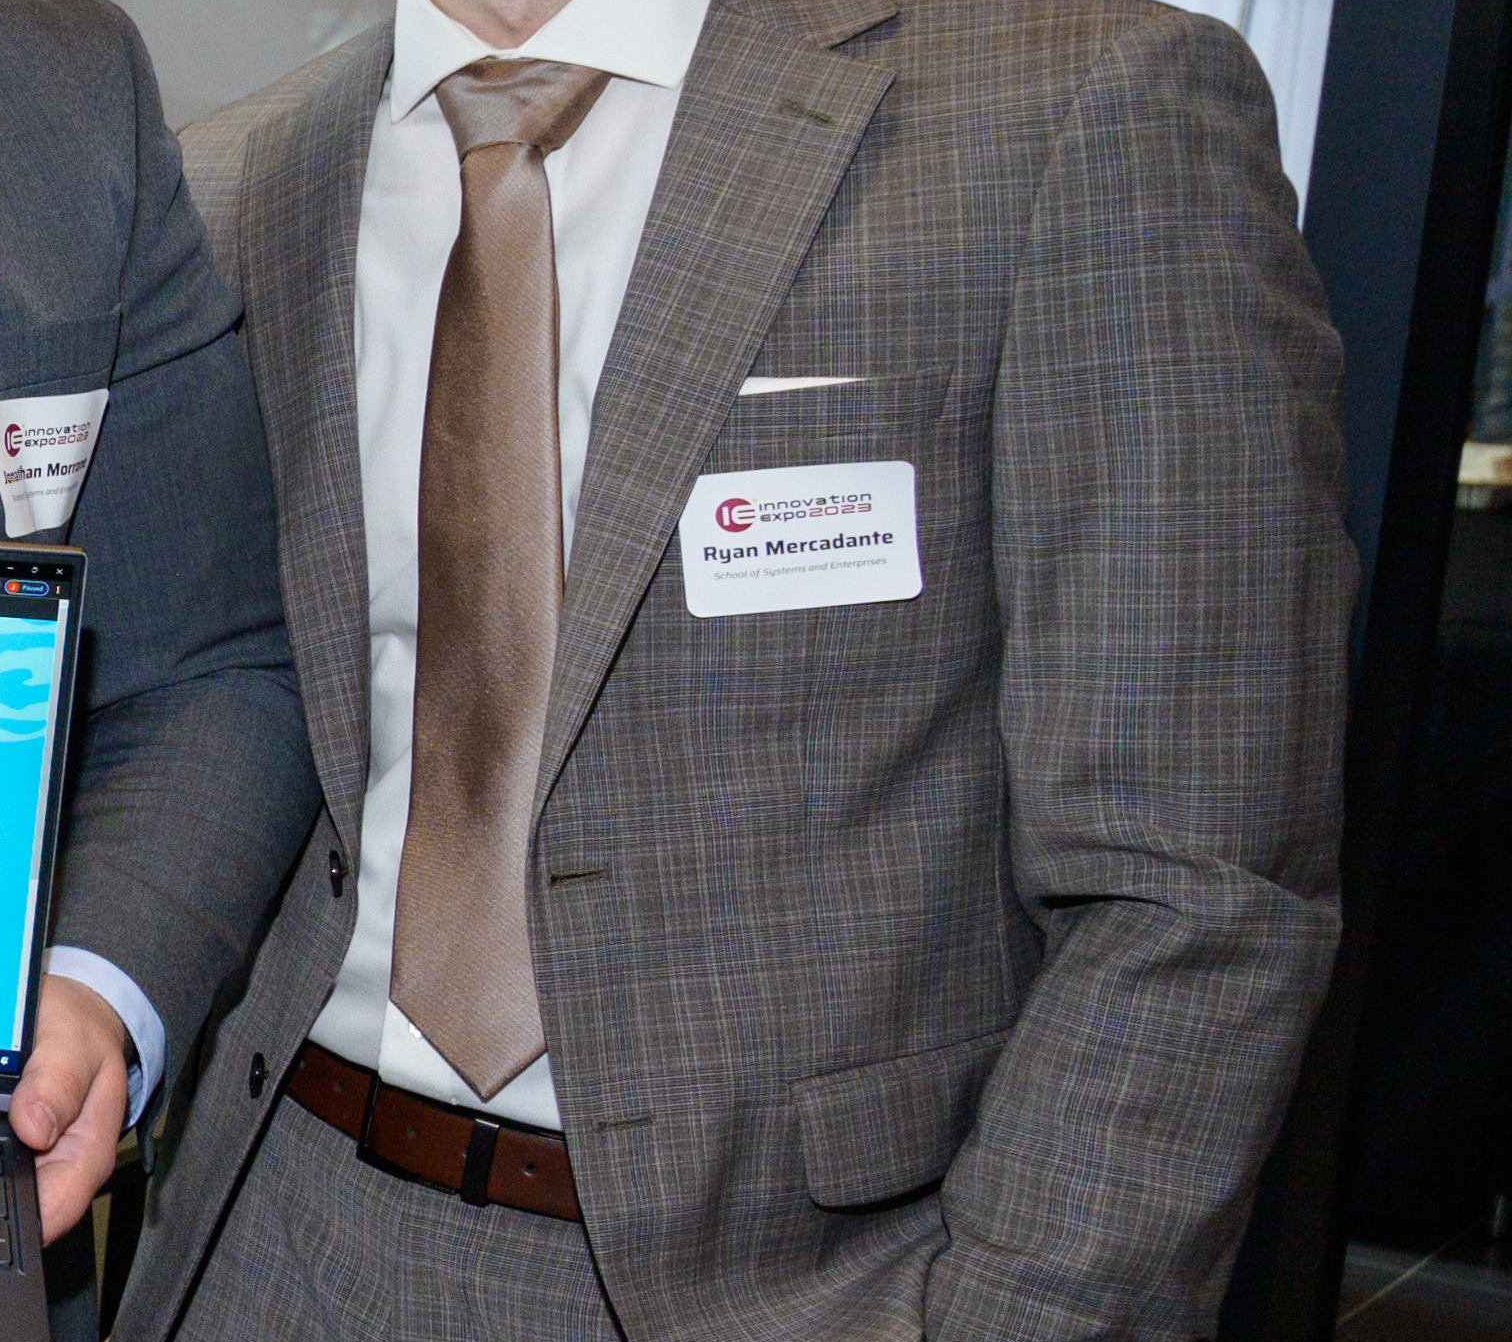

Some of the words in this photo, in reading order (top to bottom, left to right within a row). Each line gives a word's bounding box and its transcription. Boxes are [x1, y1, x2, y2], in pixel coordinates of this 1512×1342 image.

[759, 492, 872, 512] innovation
[703, 545, 758, 565] Ryan
[765, 530, 894, 557] Mercadante
[714, 570, 748, 581] School
[750, 569, 761, 579] of
[762, 565, 806, 577] Systems
[808, 562, 828, 572] and
[830, 556, 887, 569] Enterprises
